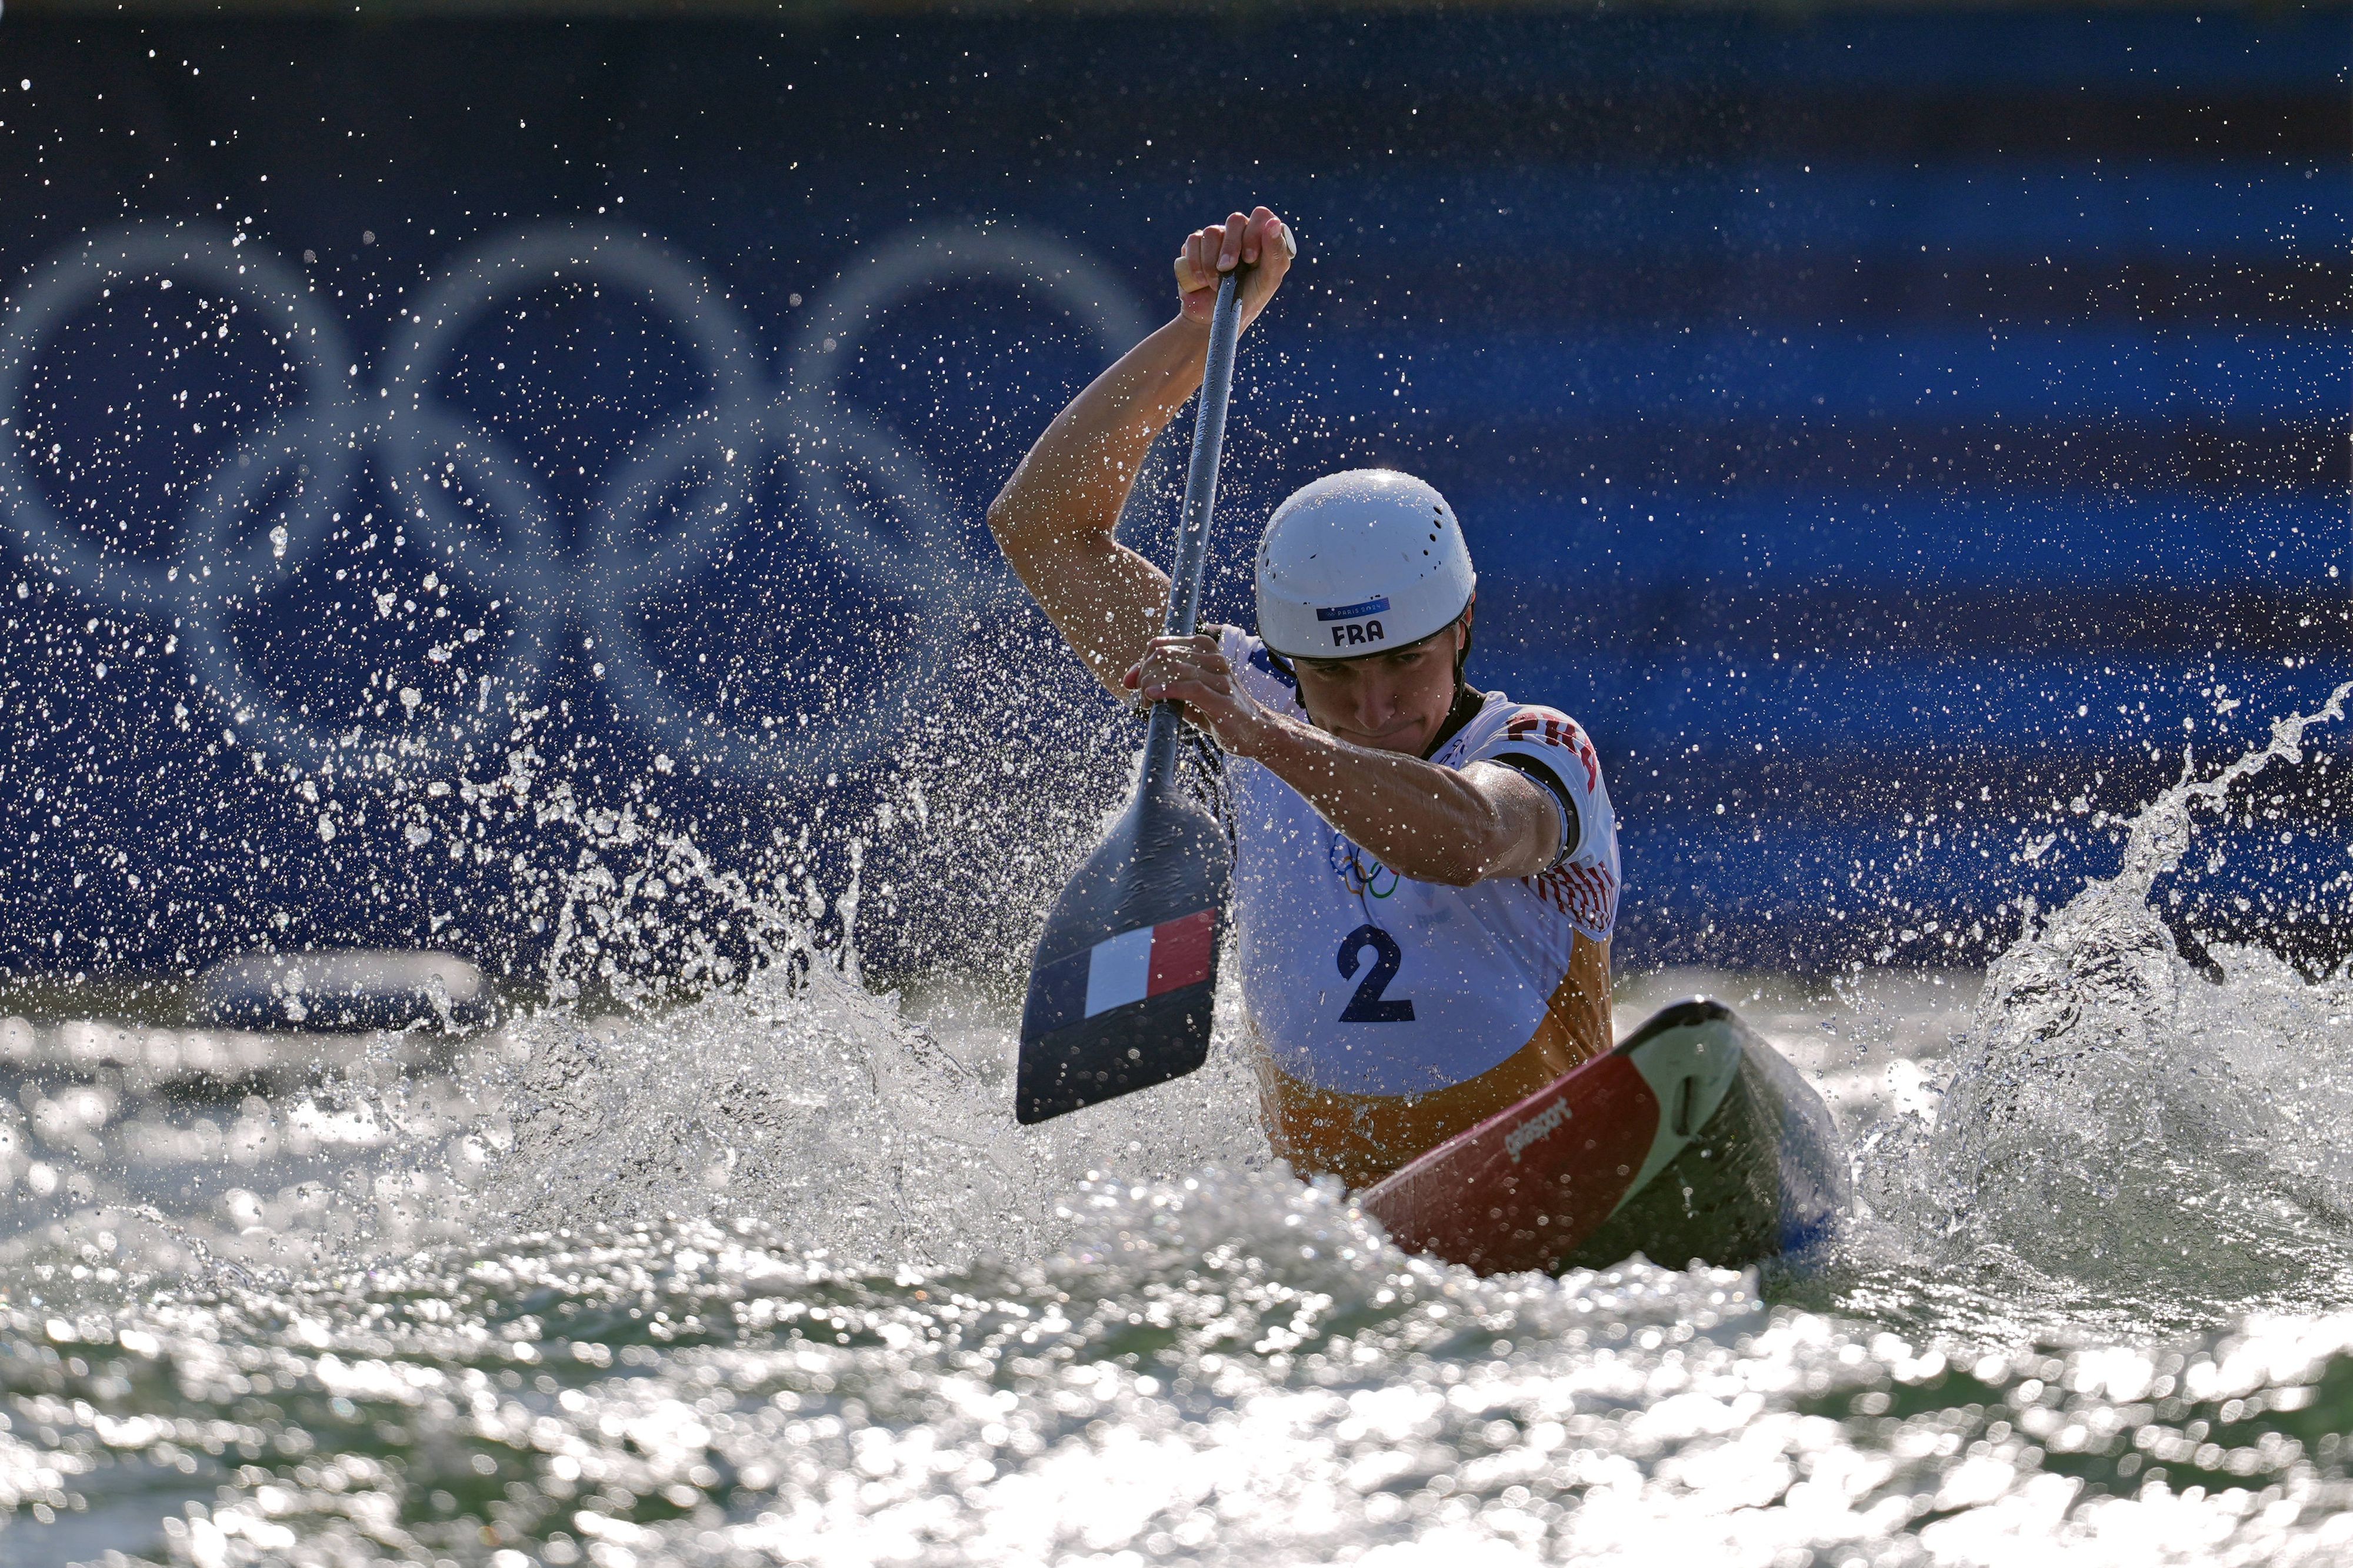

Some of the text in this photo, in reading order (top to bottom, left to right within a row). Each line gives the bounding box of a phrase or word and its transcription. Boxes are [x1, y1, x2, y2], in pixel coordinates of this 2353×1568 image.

[1338, 604, 1381, 616] PARIS 2024
[1331, 620, 1384, 647] FRA
[1337, 924, 1415, 1022] 2
